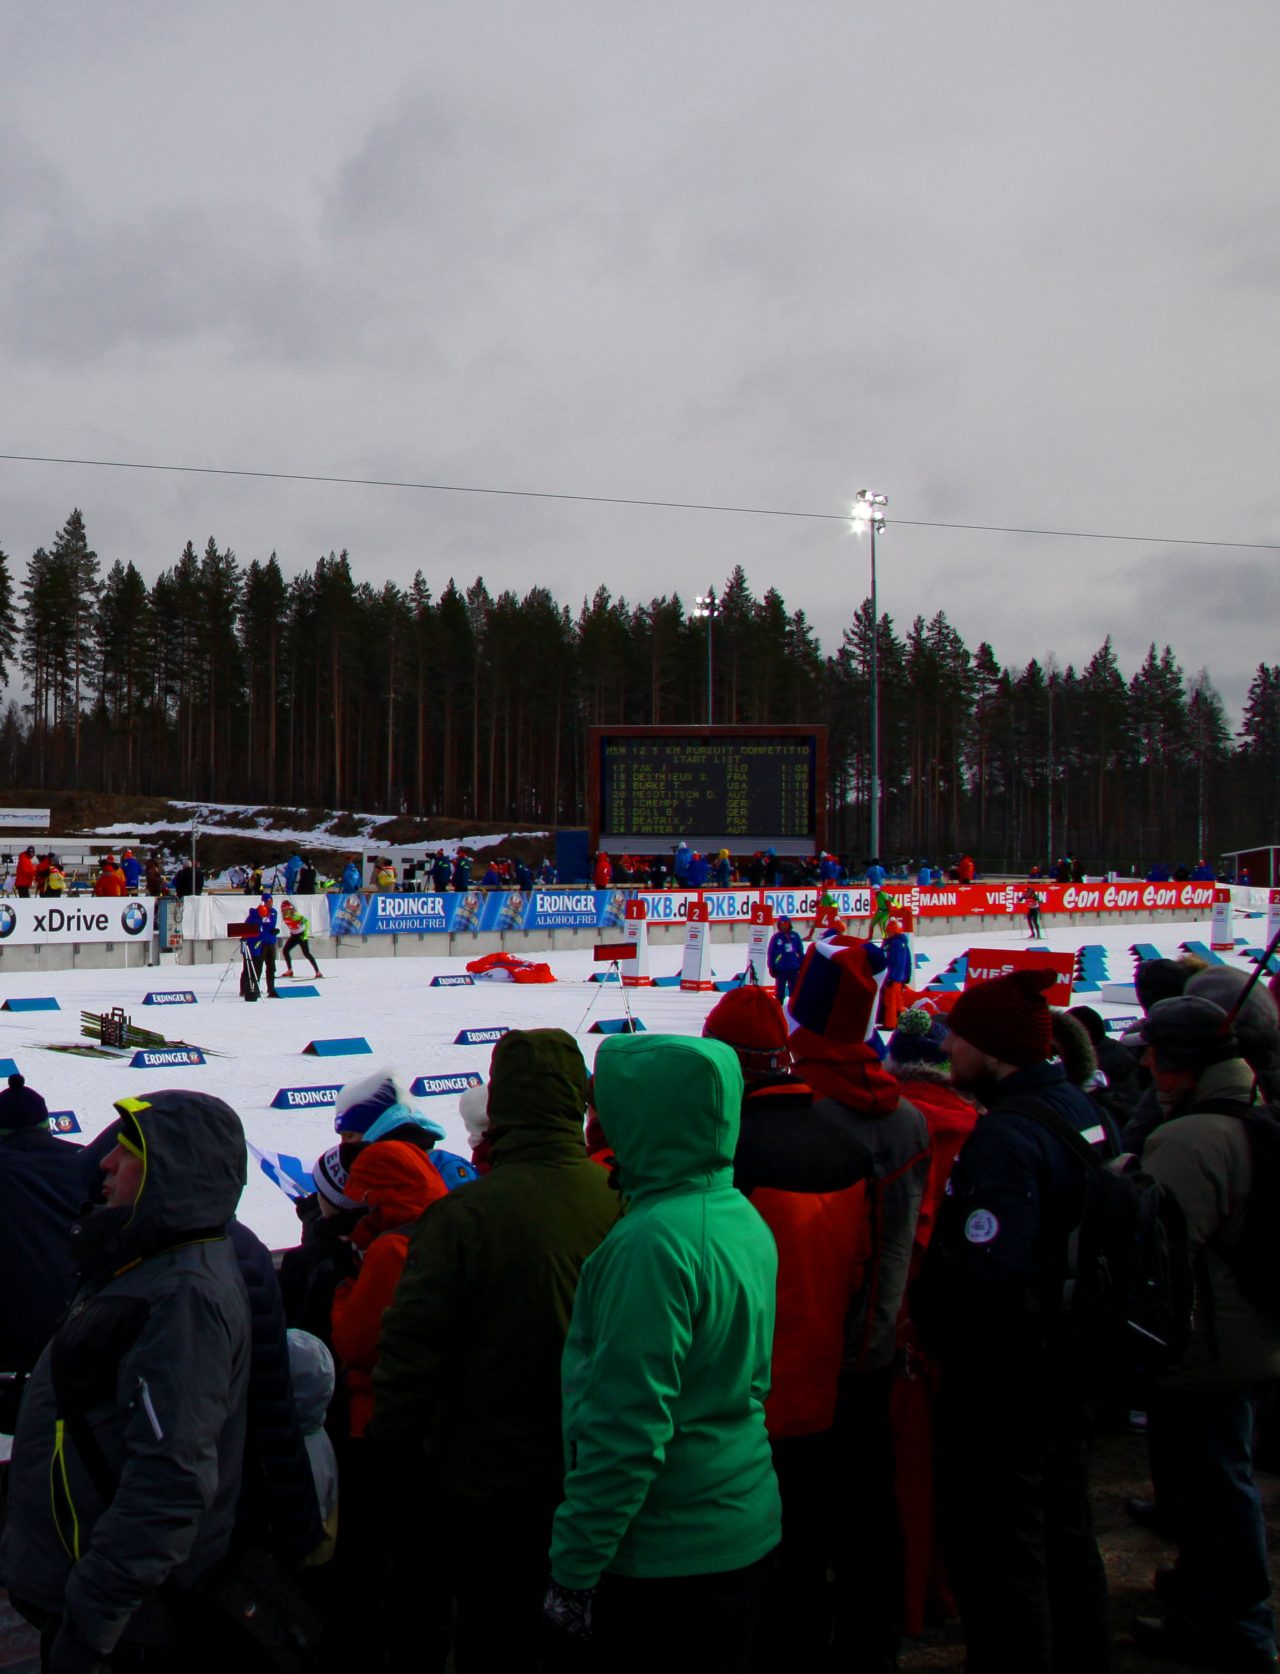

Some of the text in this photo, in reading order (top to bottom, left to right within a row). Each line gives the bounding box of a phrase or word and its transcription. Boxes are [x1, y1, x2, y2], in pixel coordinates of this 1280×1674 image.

[673, 755, 741, 763] START LIST
[727, 773, 748, 781] FRA
[727, 782, 748, 790] USA
[727, 800, 748, 808] GER
[727, 809, 748, 817] GER
[727, 818, 748, 826] FRA
[727, 826, 748, 834] AUT
[377, 896, 445, 918] ERDINGER
[536, 894, 597, 913] ERDINGER
[640, 896, 687, 918] DKB.d
[832, 893, 870, 913] KB.de
[632, 906, 637, 918] 1
[692, 908, 700, 920] 2
[756, 911, 764, 923] 3
[33, 908, 109, 933] xDrive
[376, 919, 446, 930] ALKOHOLFREI
[535, 915, 597, 925] ALKOHOLFREI
[822, 914, 829, 926] 4
[438, 976, 466, 986] ERDINGER
[152, 993, 185, 1004] ERDINGER
[466, 1030, 501, 1042] ERDINGER
[144, 1052, 190, 1066] ERDINGER
[424, 1077, 469, 1094] ERDINGER
